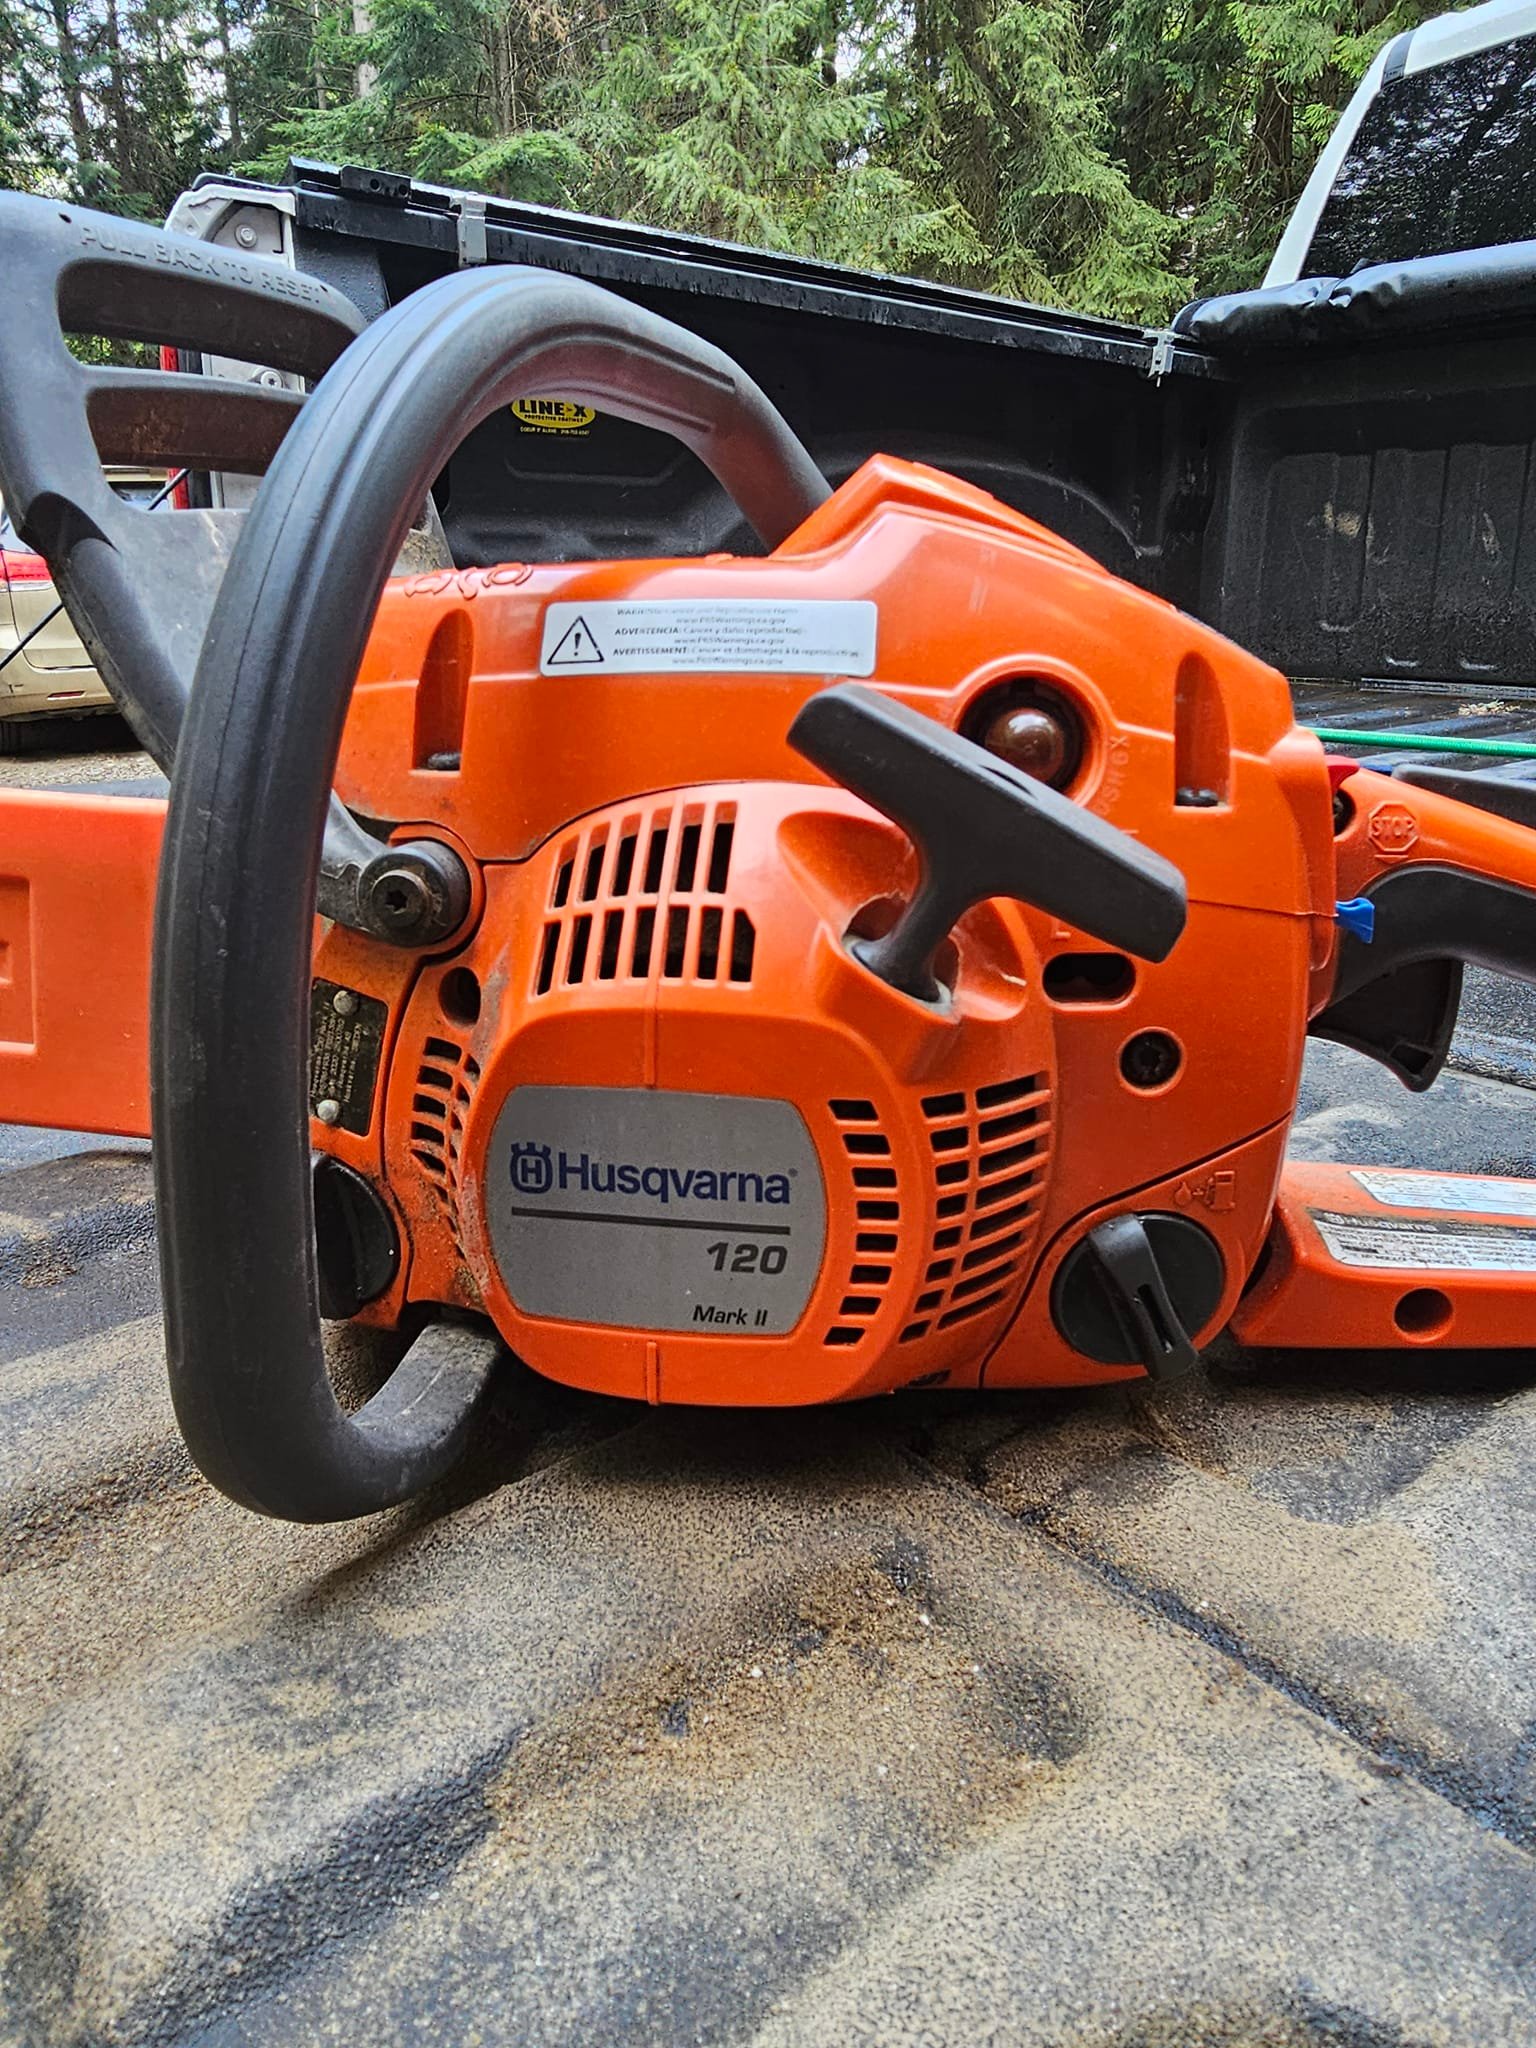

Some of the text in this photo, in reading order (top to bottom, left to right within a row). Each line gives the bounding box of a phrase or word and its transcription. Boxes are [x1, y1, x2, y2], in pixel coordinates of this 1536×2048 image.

[81, 227, 320, 304] PULL BACK TO RESET
[519, 400, 587, 417] LINE-X
[613, 646, 689, 656] AVERTISSEMENT:
[1372, 816, 1415, 839] STOP
[558, 1152, 791, 1204] Husqvarna
[706, 1241, 788, 1275] 120
[692, 1304, 768, 1326] Mark II
